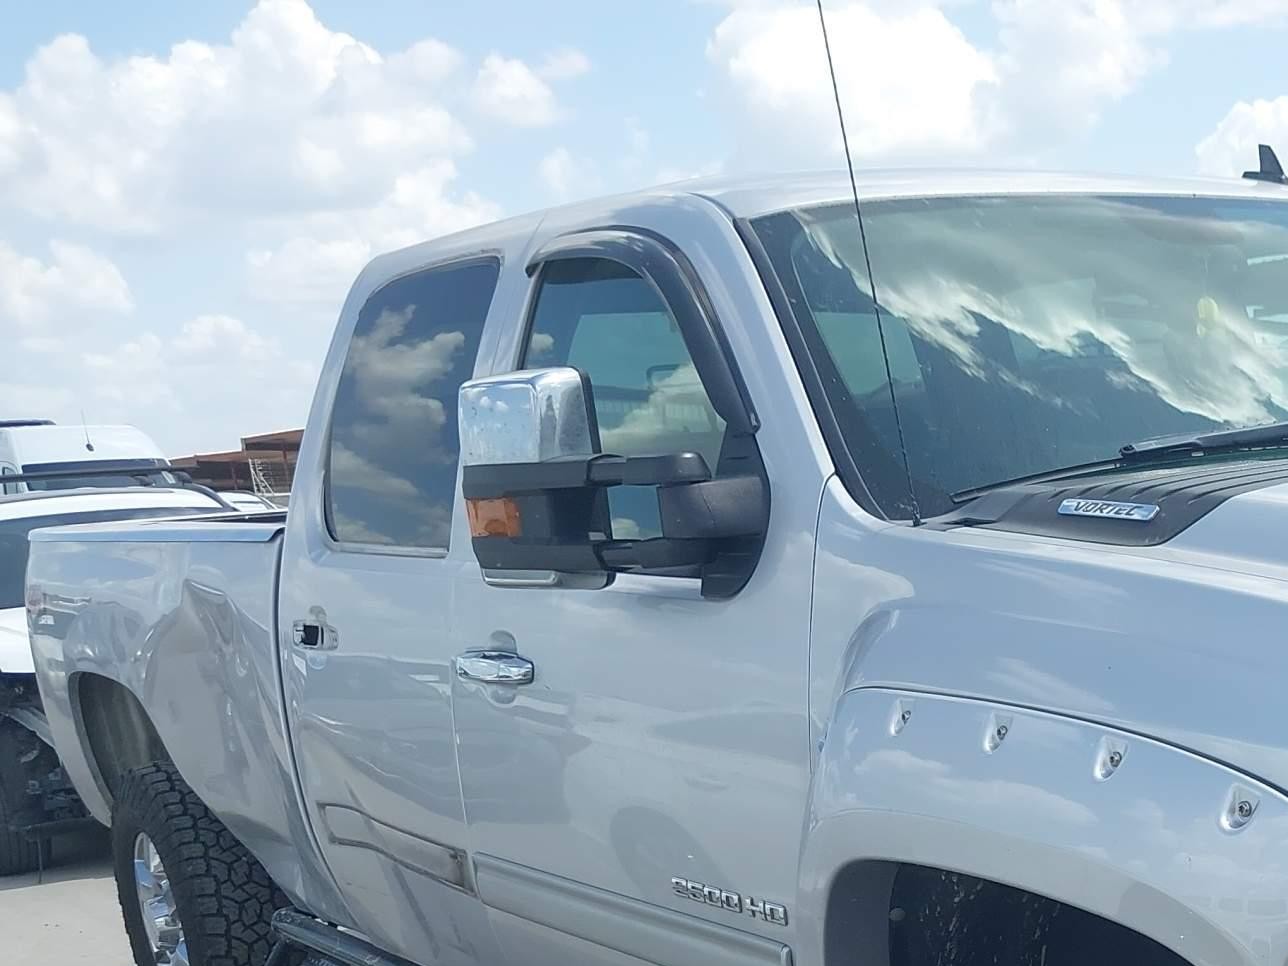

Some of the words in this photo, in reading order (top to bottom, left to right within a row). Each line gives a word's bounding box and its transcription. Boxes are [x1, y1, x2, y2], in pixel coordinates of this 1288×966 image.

[1074, 501, 1144, 517] VORTEC
[671, 876, 743, 913] 2500
[745, 896, 789, 927] HD
